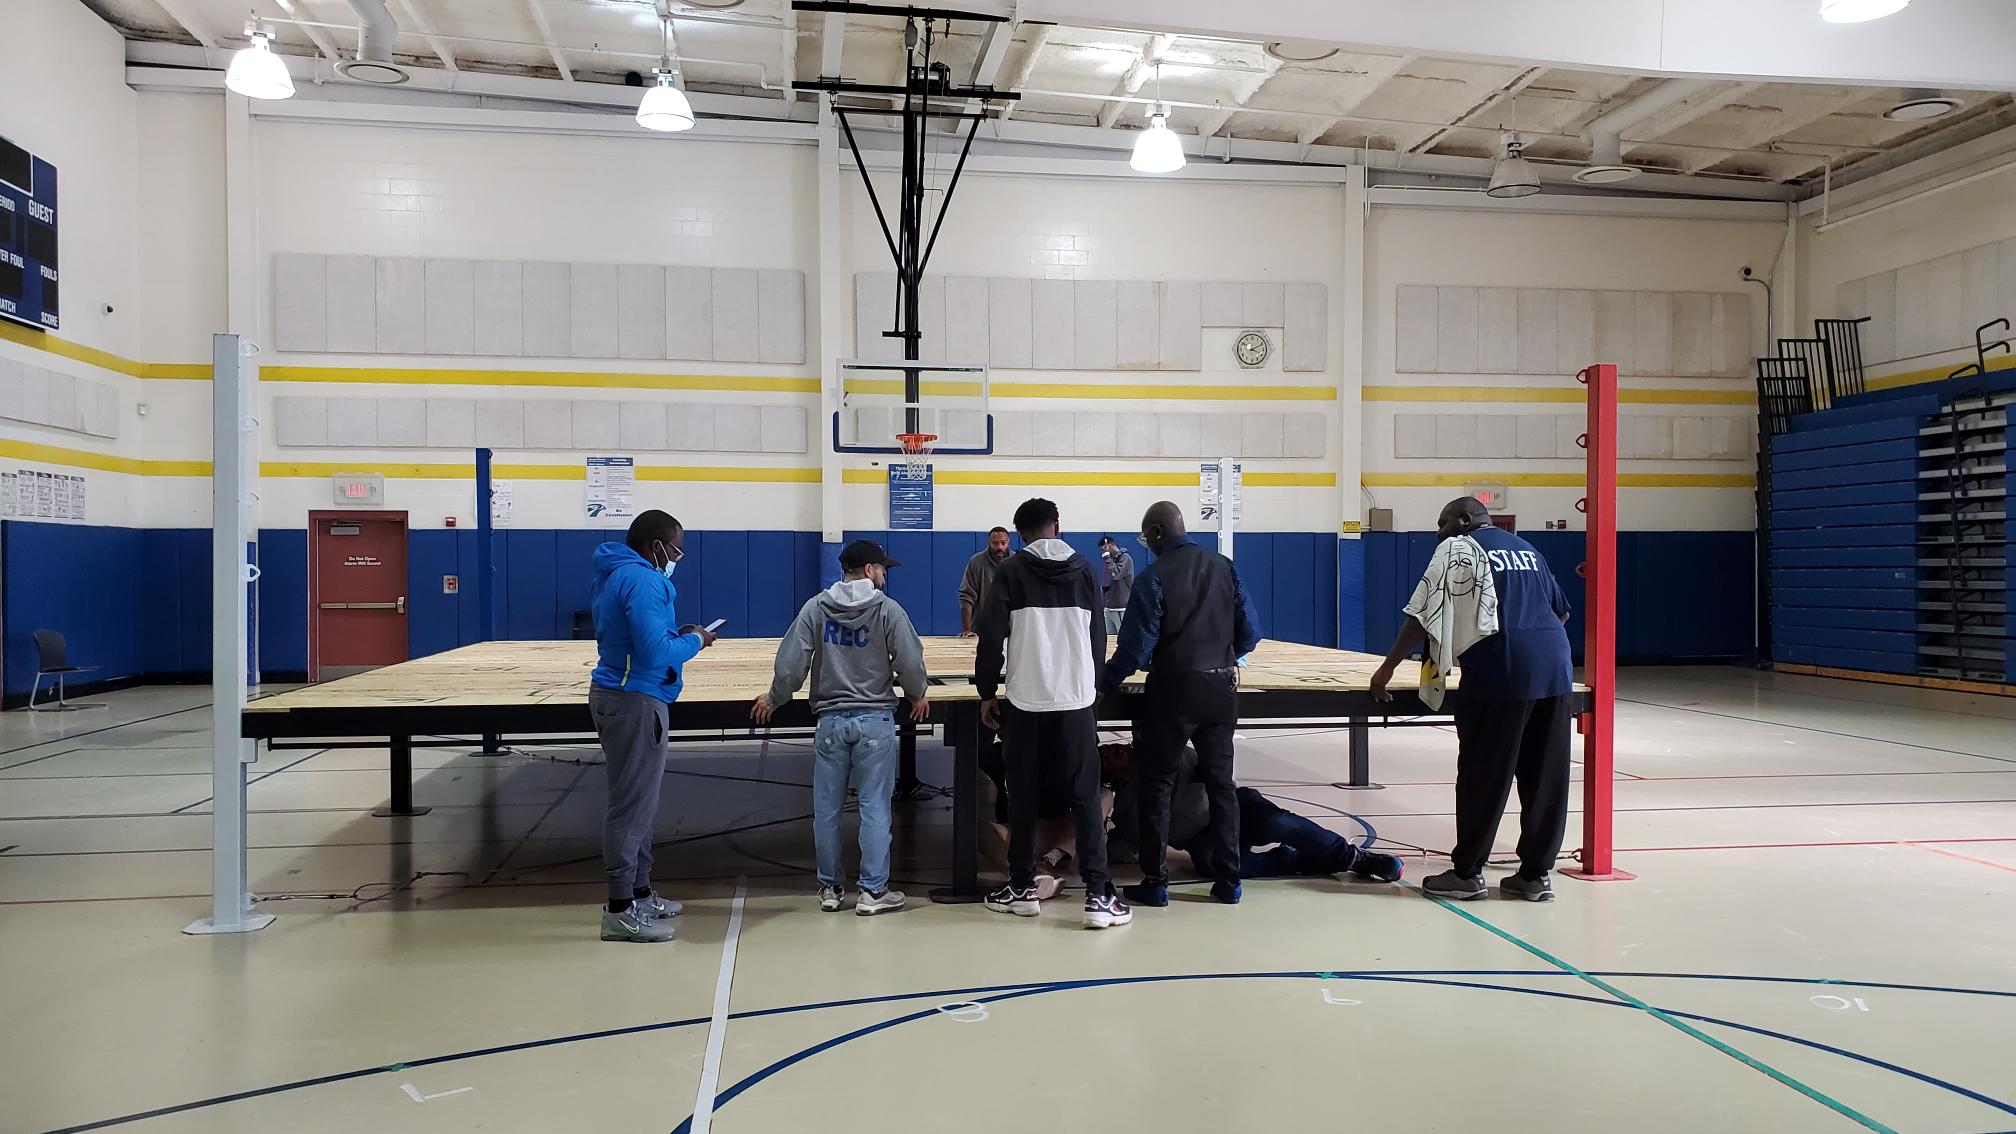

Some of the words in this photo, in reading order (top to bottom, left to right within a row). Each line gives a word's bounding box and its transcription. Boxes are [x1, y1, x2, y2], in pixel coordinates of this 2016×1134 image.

[28, 199, 54, 225] GUEST
[10, 252, 24, 269] FOUL
[40, 265, 57, 282] FOULS
[41, 311, 58, 327] SCORE
[1487, 549, 1539, 572] STAFF
[824, 620, 870, 648] REC
